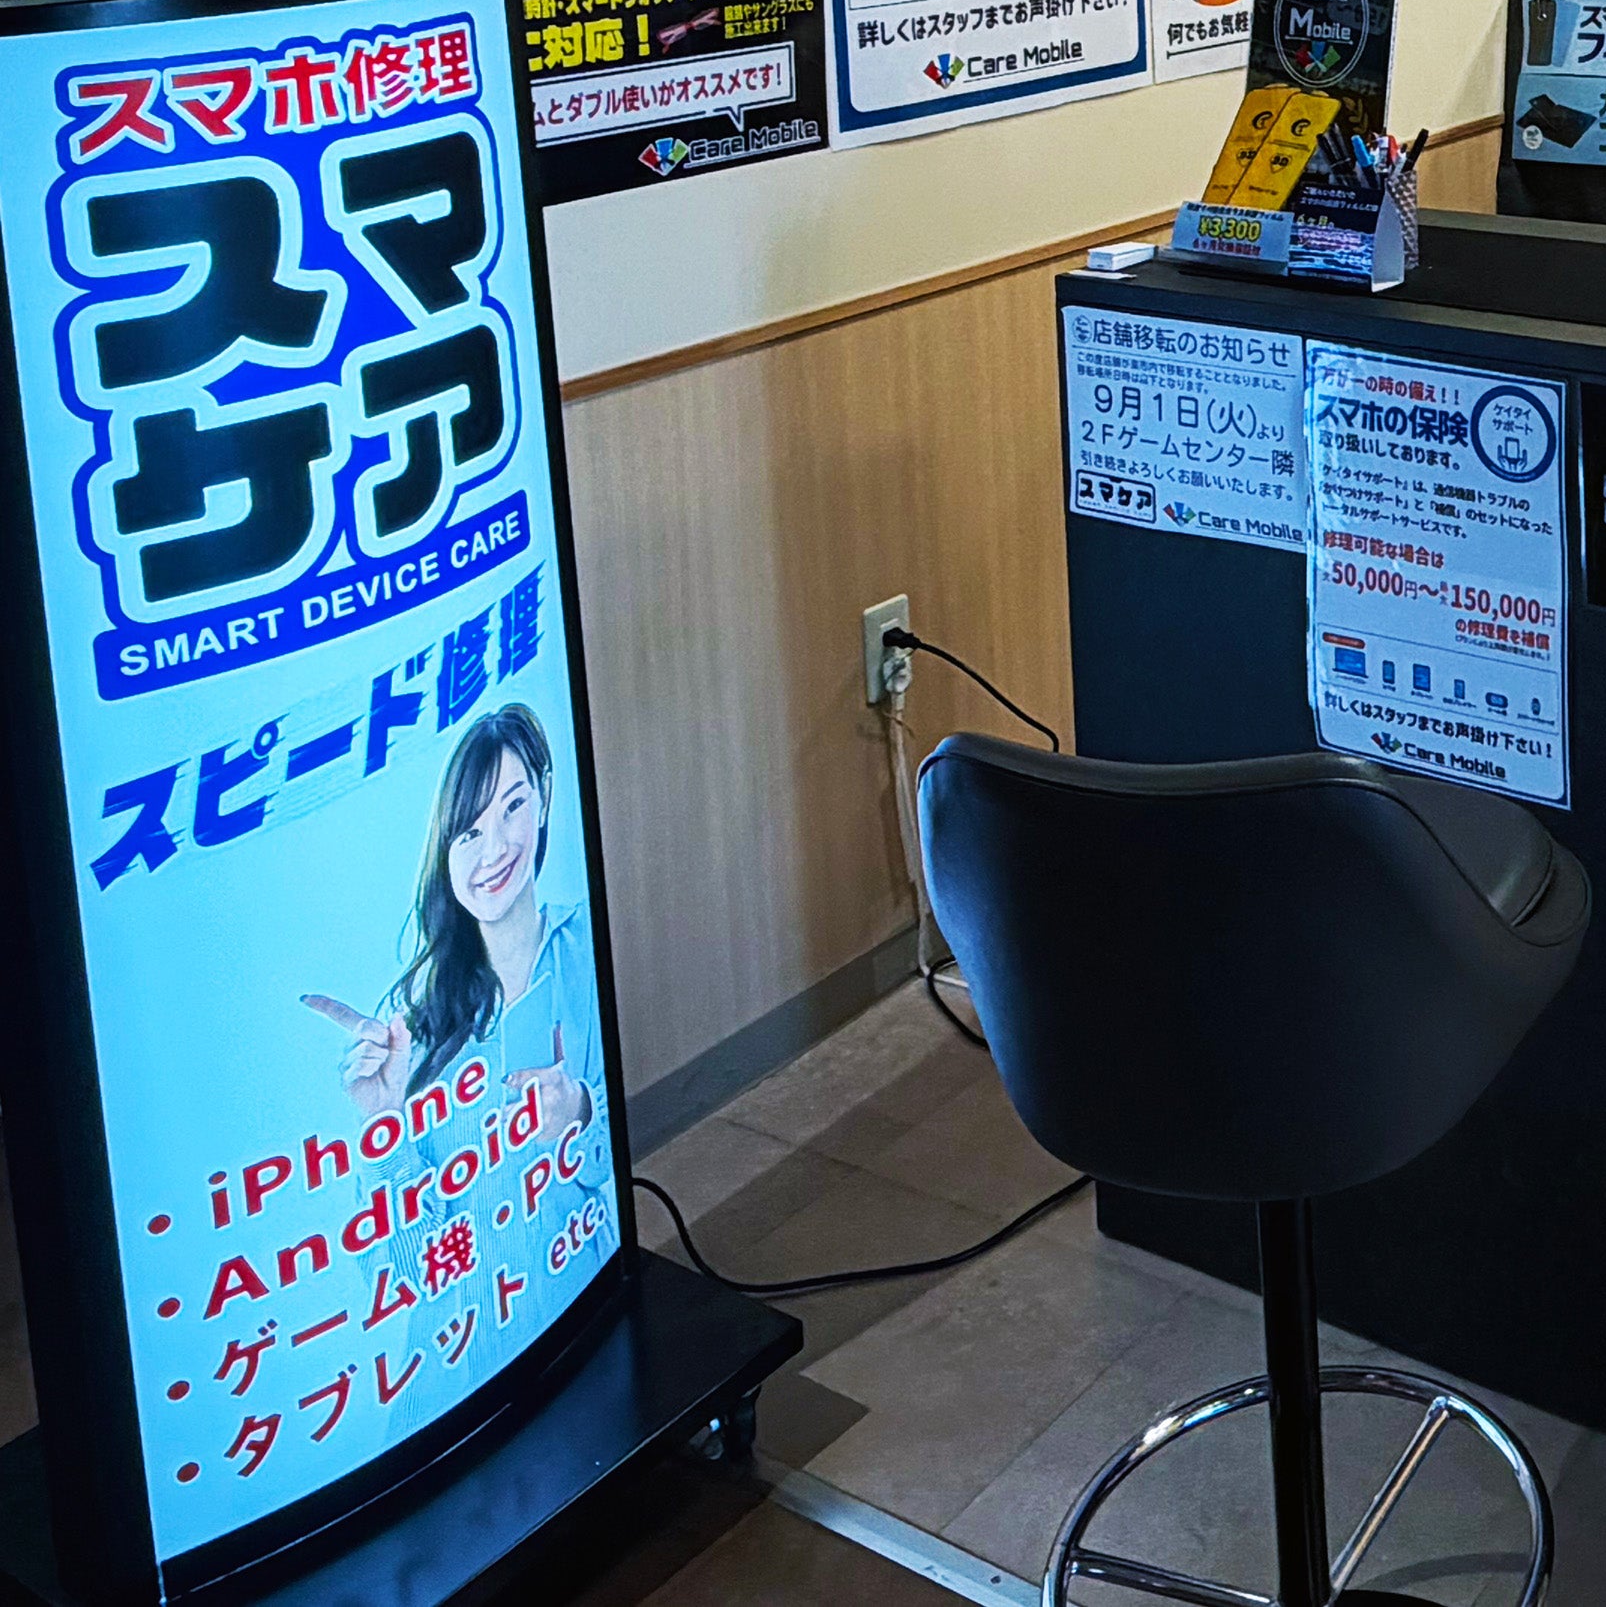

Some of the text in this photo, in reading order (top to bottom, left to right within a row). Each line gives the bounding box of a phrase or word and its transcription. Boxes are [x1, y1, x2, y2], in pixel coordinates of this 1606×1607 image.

[1289, 9, 1351, 41] Mobile
[967, 40, 1083, 77] Care Mobile
[78, 28, 473, 157] スマホ修理
[690, 119, 820, 163] Care Mobile
[1093, 319, 1290, 367] 店舗移転のお知らせ
[1094, 385, 1285, 442] 9月1日(火)より
[1317, 395, 1469, 447] スマホの保険
[1493, 404, 1532, 420] ケイタイ
[1493, 418, 1533, 435] サポート
[1082, 420, 1295, 477] 2Fゲームセンター隣
[1079, 478, 1152, 510] スマケア
[1080, 450, 1293, 502] 引き続きよろしくお願いいたします。
[1199, 511, 1302, 542] Care Mobile
[1323, 530, 1445, 569] 修理可能な場合は
[119, 511, 522, 677] SMART DEVICE CARE
[89, 560, 547, 893] スピード修理
[1404, 744, 1507, 779] Care Mobile
[208, 1059, 487, 1230] iPhone
[203, 1082, 541, 1320] Android
[224, 1268, 527, 1477] タブレット
